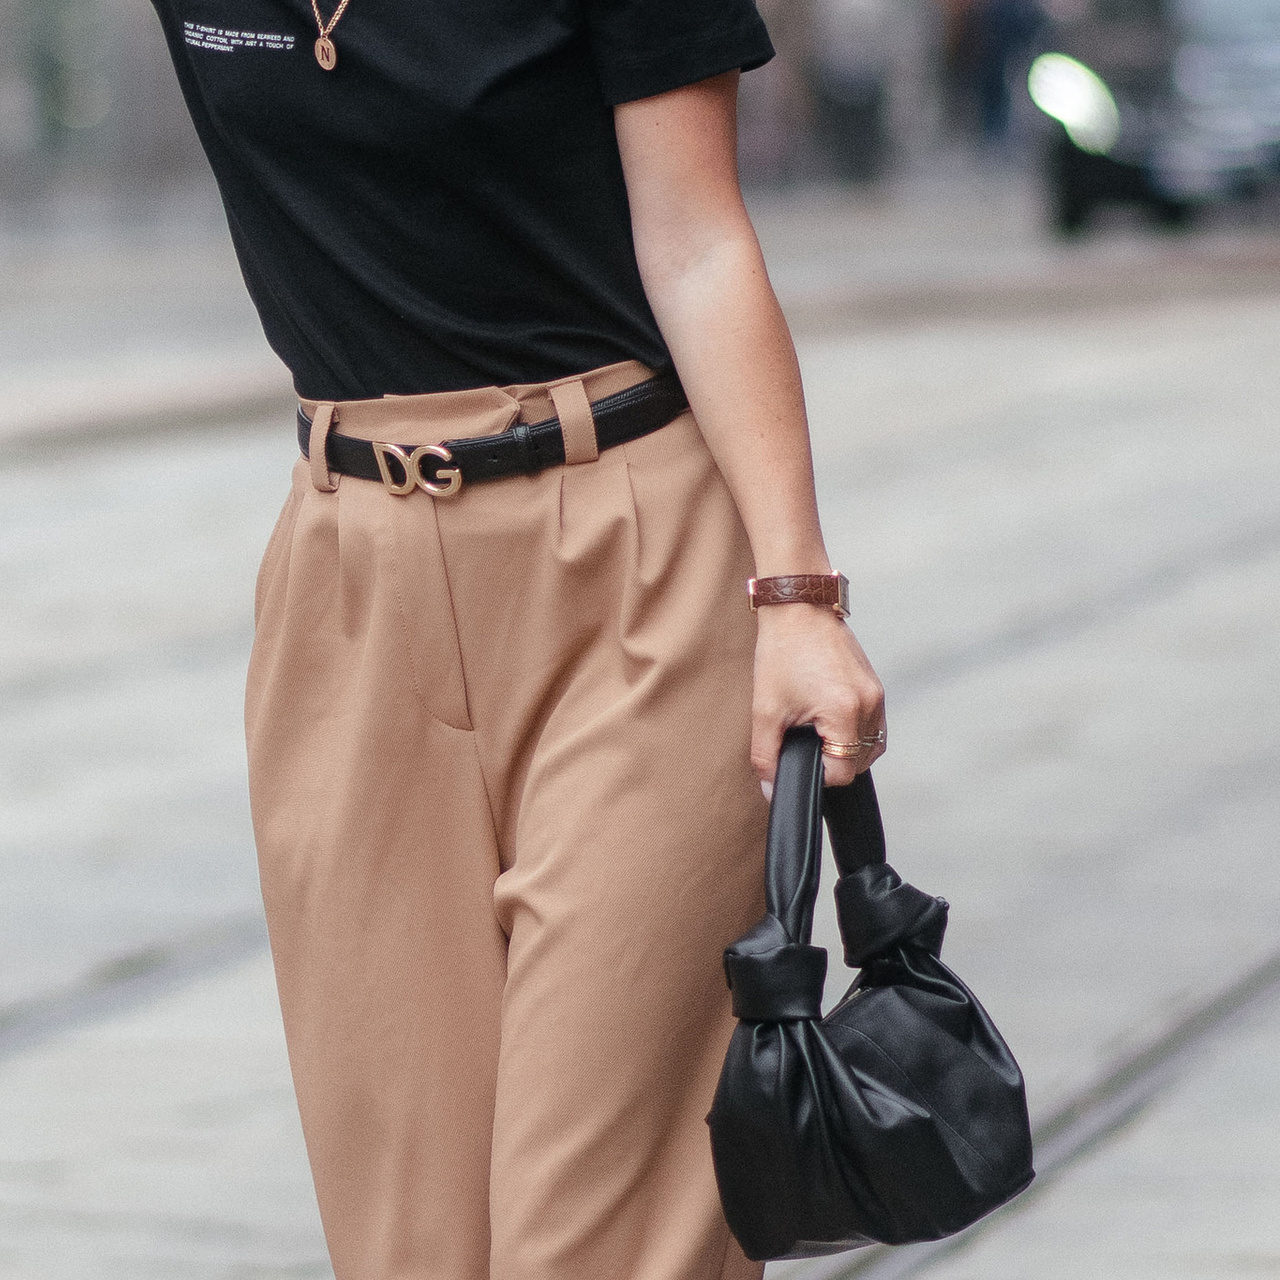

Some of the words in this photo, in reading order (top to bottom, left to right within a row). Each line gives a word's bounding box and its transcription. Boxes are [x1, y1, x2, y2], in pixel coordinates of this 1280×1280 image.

[195, 24, 217, 34] T-SHIRT
[257, 33, 281, 41] SEAWEED
[320, 44, 330, 62] N
[372, 442, 462, 497] DG
